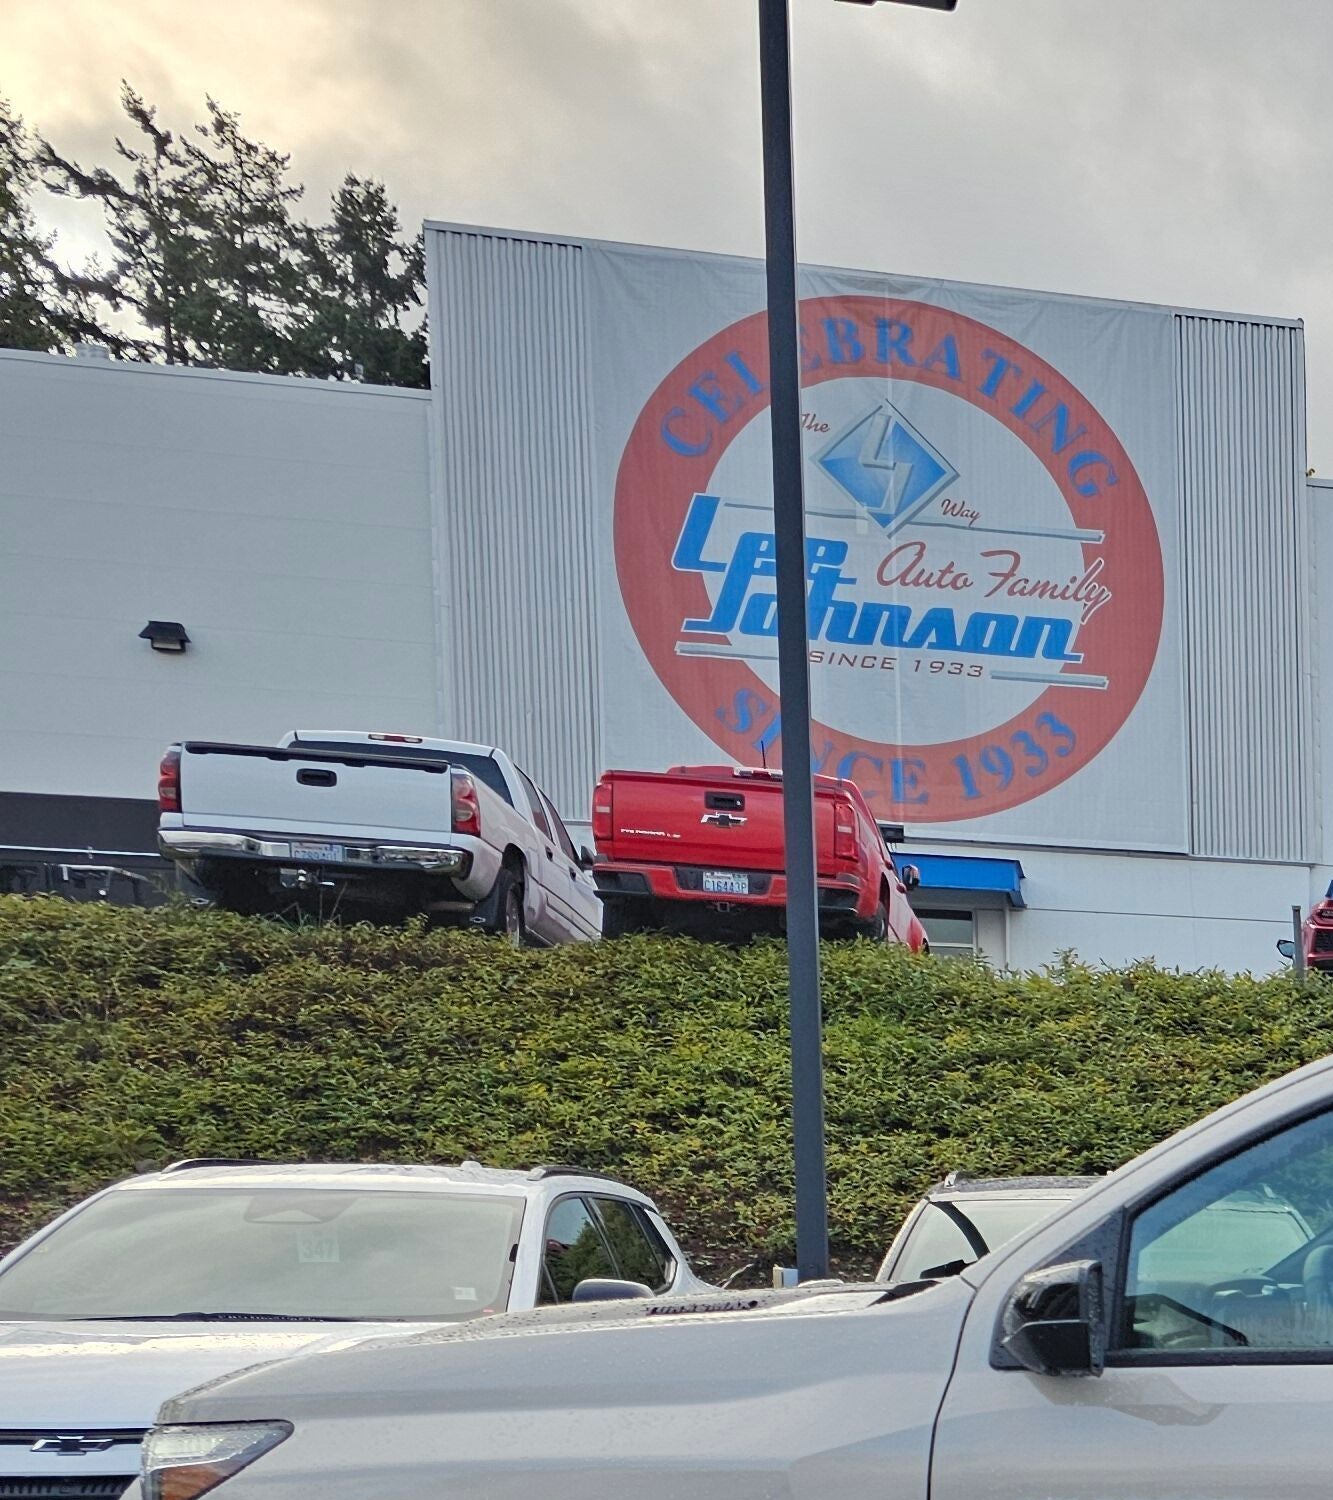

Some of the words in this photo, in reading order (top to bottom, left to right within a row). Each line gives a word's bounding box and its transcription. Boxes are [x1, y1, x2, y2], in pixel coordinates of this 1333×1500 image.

[672, 494, 857, 585] Lee
[940, 498, 982, 528] Way
[682, 565, 1082, 662] Johnson
[876, 541, 974, 590] Auto
[979, 549, 1111, 623] Family
[809, 650, 897, 670] SINCE
[913, 659, 984, 678] 1933
[952, 711, 1077, 799] 1933
